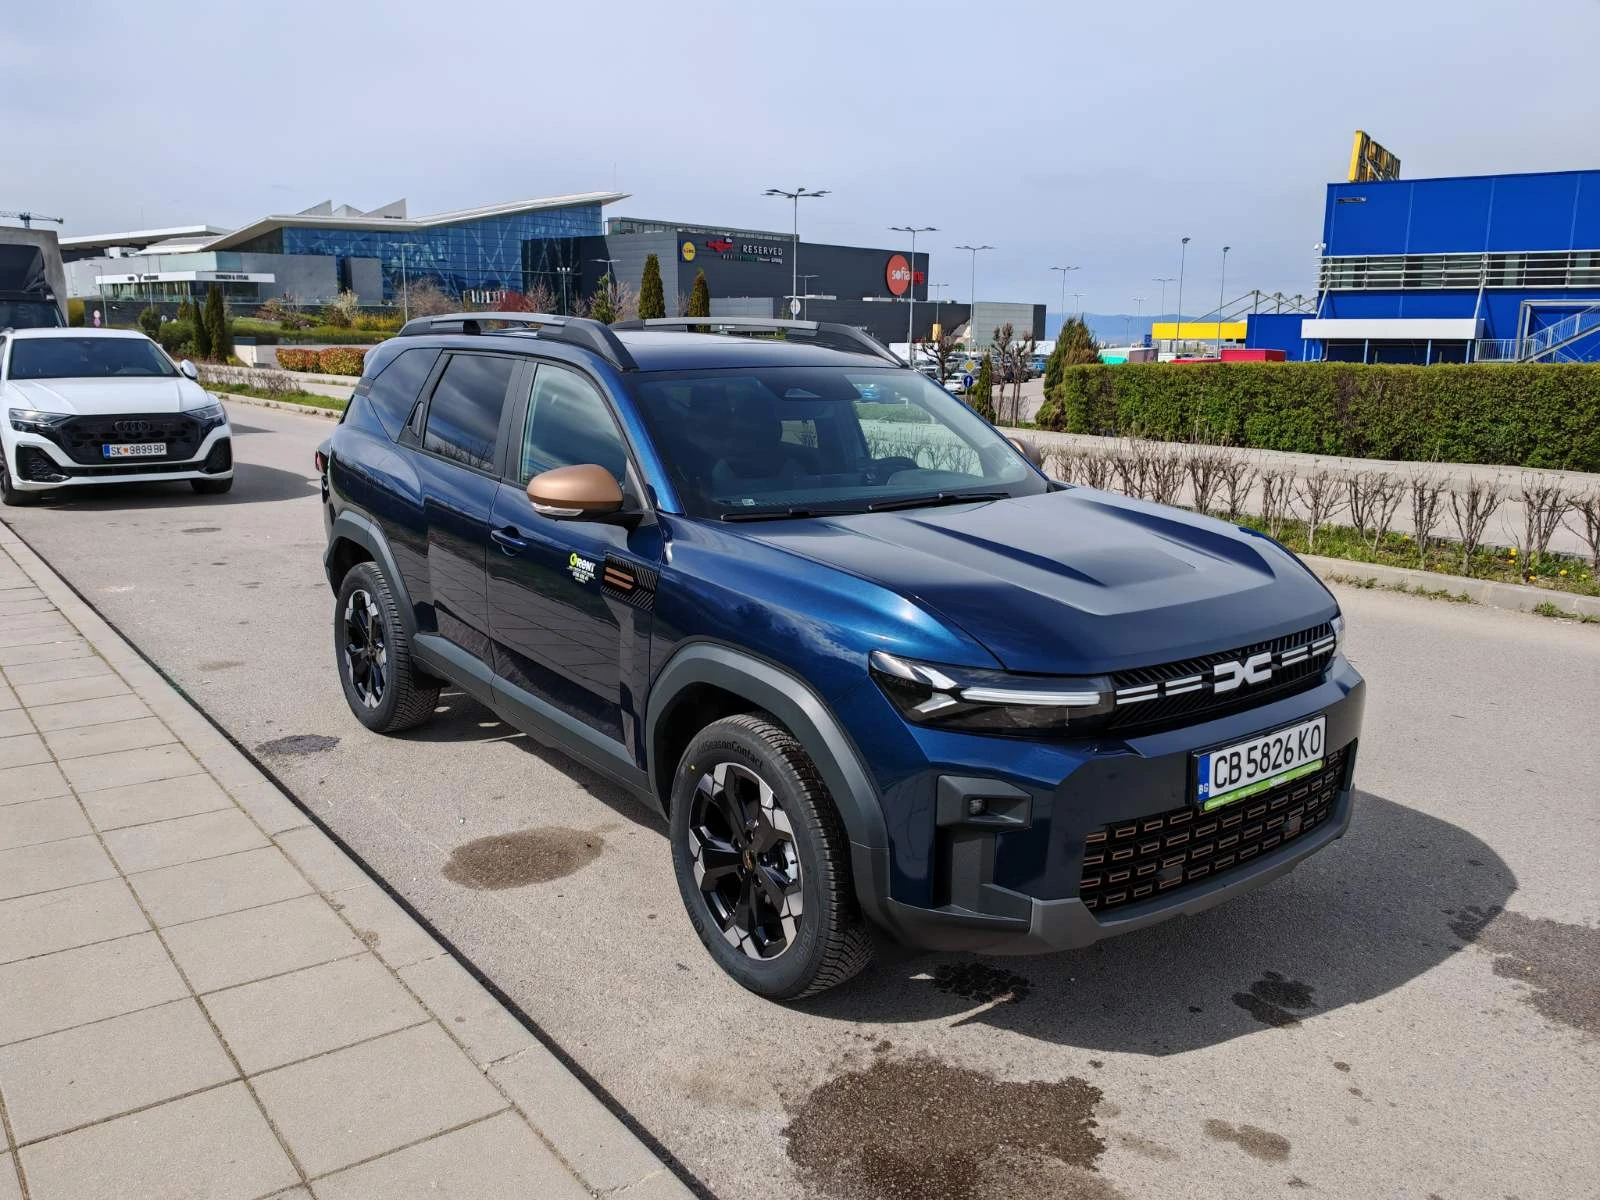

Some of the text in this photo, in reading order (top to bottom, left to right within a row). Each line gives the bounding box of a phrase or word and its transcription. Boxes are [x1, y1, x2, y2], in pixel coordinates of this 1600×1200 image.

[742, 244, 783, 256] RESERVED
[891, 266, 911, 281] sofia
[1214, 751, 1242, 789] CB
[1246, 733, 1294, 778] 5826
[1198, 782, 1209, 795] BG
